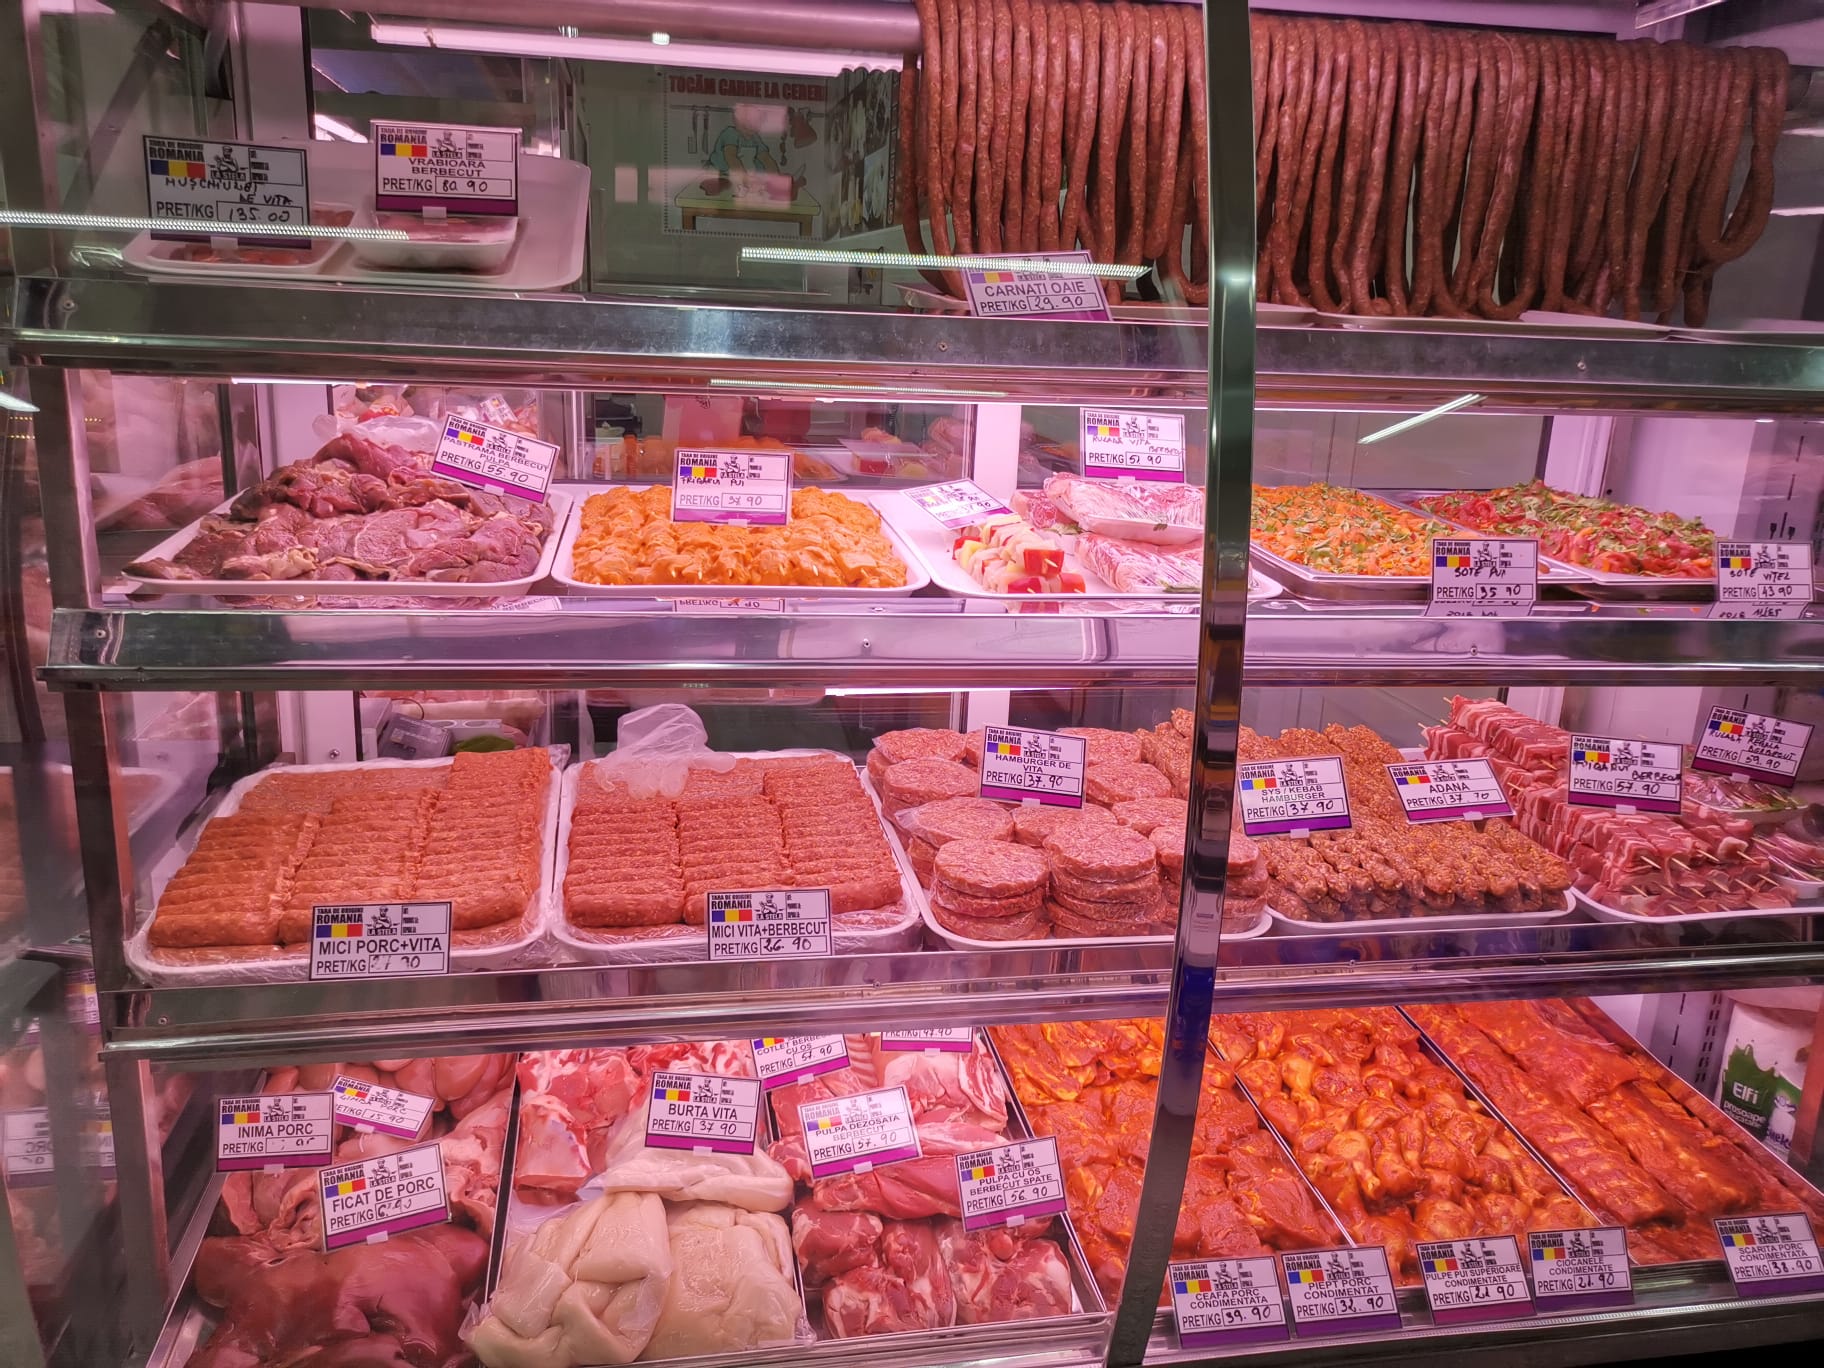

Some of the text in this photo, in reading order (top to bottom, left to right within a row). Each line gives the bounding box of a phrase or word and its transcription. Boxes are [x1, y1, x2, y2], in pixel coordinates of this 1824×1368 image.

[764, 82, 780, 99] LA
[380, 134, 427, 145] ROMANIA
[150, 148, 204, 161] ROMANIA
[408, 158, 486, 168] VRABIOARA
[411, 166, 482, 177] BERBECUT
[383, 178, 432, 191] PRET/KG
[156, 202, 214, 218] PRET/KG
[985, 281, 1086, 297] CARNATI OAIE
[980, 300, 1027, 312] PRET/KG
[1087, 417, 1120, 426] ROMANIA
[448, 421, 486, 438] ROMANIA
[440, 451, 482, 470] PRET/KG
[443, 437, 549, 472] PASTRAMA BERBECUT
[479, 453, 510, 468] PULPA
[1089, 452, 1125, 463] PRET/KG
[680, 458, 718, 467] ROMANIA
[680, 494, 719, 506] PRET/KG
[1436, 547, 1471, 556] ROMANIA
[1437, 586, 1474, 598] PRET/KG
[1723, 587, 1756, 598] PRET/KG
[987, 733, 1022, 745] ROMANIA
[1701, 745, 1738, 761] PRET/KG
[995, 754, 1057, 768] HAMBURGER
[1023, 764, 1043, 773] VITA
[986, 771, 1023, 784] PRET/KG
[1289, 785, 1323, 794] KEBAB
[1429, 782, 1470, 794] ADANA
[1574, 778, 1613, 791] PRET/KG
[1261, 792, 1325, 803] HAMBURGER
[1406, 796, 1444, 807] PRET/KG
[1247, 806, 1285, 818] PRET/KG
[711, 899, 752, 909] ROMANIA
[317, 913, 363, 924] ROMANIA
[712, 921, 827, 938] MICI VITA+BERBECUT
[319, 937, 442, 955] MICI PORC+VITA
[714, 942, 758, 955] PRET/KG
[316, 960, 366, 973] PRET/KG
[757, 1042, 790, 1056] COTLET
[799, 1043, 812, 1051] OS
[760, 1058, 794, 1074] PRET/KG
[655, 1079, 691, 1090] ROMANIA
[222, 1104, 260, 1113] ROMANIA
[668, 1103, 738, 1120] BURTA VITA
[238, 1123, 313, 1138] INIMA PORC
[652, 1118, 691, 1131] PRET/KG
[815, 1114, 901, 1136] PULPA DEZOSATA
[833, 1125, 885, 1141] BERBECUT
[223, 1142, 264, 1154] PRET/KG
[814, 1143, 852, 1159] PRET/KG
[960, 1156, 994, 1170] ROMANIA
[324, 1169, 365, 1186] ROMANIA
[979, 1168, 1041, 1186] PULPA CU OS
[970, 1173, 1053, 1196] BERBECUT SPATE
[332, 1192, 371, 1213] FICAT
[375, 1188, 393, 1202] DE
[397, 1176, 435, 1196] PORC
[967, 1194, 1003, 1212] PRET/KG
[330, 1209, 374, 1229] PRET/KG
[1421, 1250, 1455, 1261] ROMANIA
[1739, 1243, 1804, 1255] SCARITA PORC
[1556, 1257, 1604, 1267] CIOCANELE
[1739, 1251, 1808, 1262] CONDIMENTATA
[1286, 1259, 1322, 1271] ROMANIA
[1549, 1264, 1614, 1276] CONDIMENTATE
[1173, 1269, 1210, 1282] ROMANIA
[1425, 1264, 1521, 1280] PULPE PUI SUPERIOARE
[1734, 1265, 1769, 1279] PRET/KG
[1308, 1277, 1372, 1291] PIEPT PORC
[1445, 1275, 1508, 1288] CONDIMENTATE
[1537, 1279, 1573, 1292] PRET/KG
[1195, 1288, 1260, 1301] CEAFA PORC
[1304, 1286, 1379, 1300] CONDIMENTAT
[1433, 1291, 1470, 1305] PRET/KG
[1190, 1295, 1269, 1309] CONDIMENTATA
[1296, 1302, 1335, 1318] PRET/KG
[1182, 1314, 1221, 1328] PRET/KG
